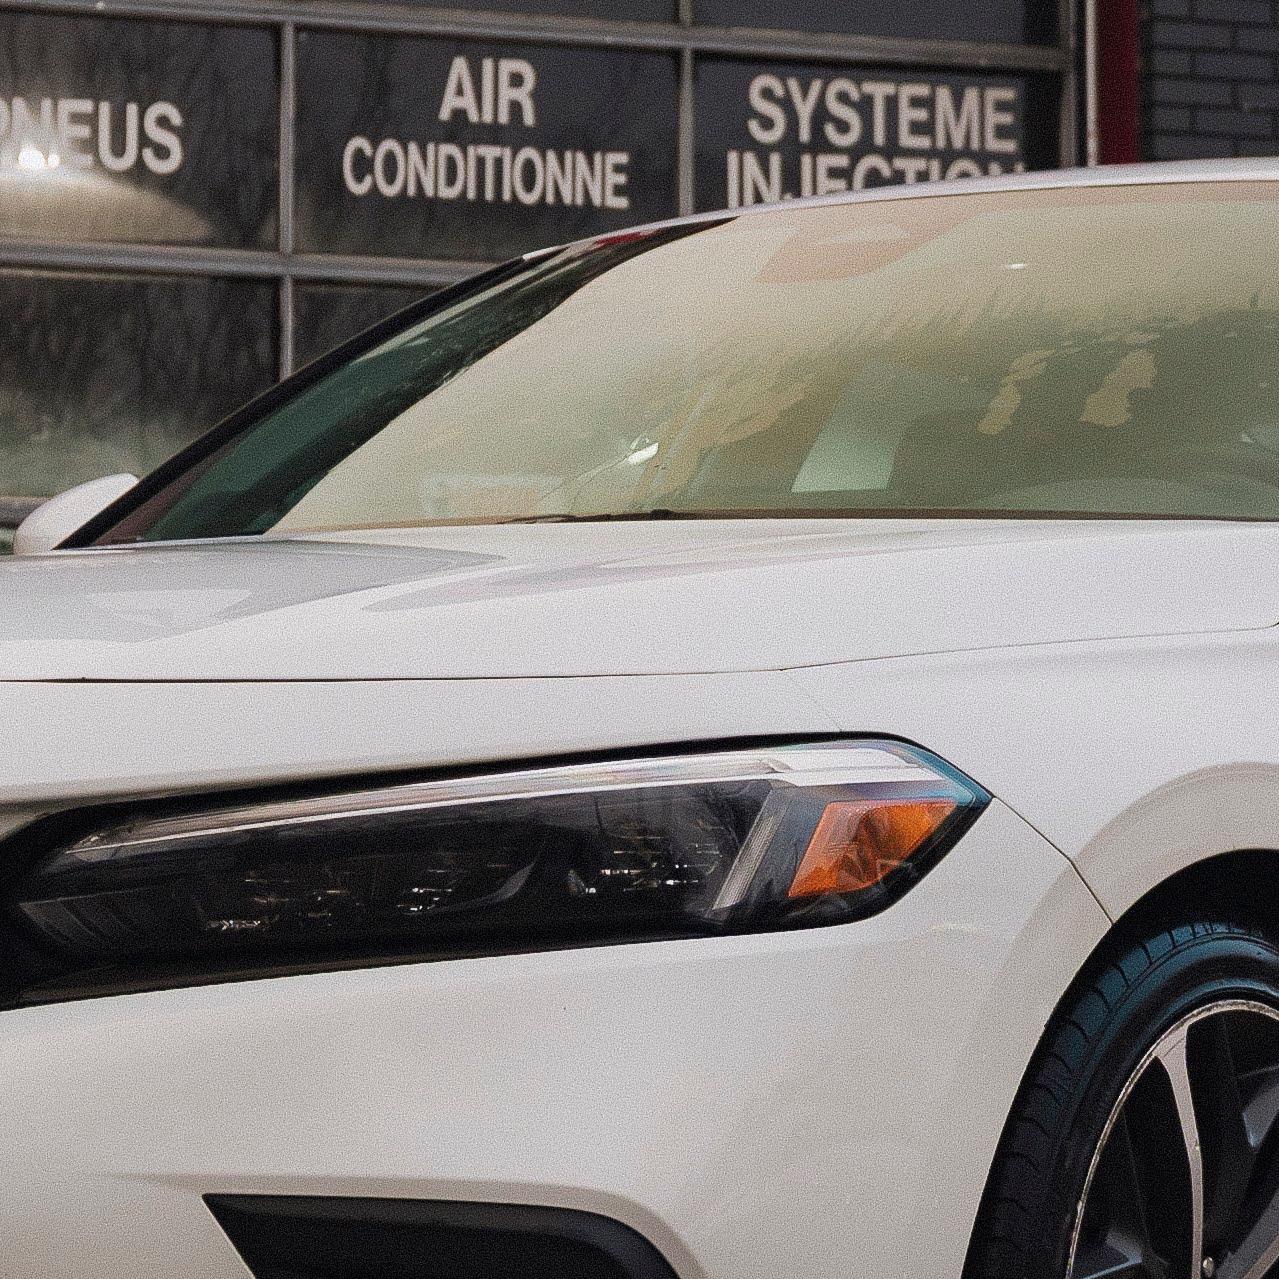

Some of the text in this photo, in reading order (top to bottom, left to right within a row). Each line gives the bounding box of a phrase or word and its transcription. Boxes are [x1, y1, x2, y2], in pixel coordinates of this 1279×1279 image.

[440, 56, 537, 128] AIR
[747, 73, 1018, 153] SYSTEME
[342, 136, 629, 210] CONDITIONNE
[726, 150, 1026, 209] INJECT
